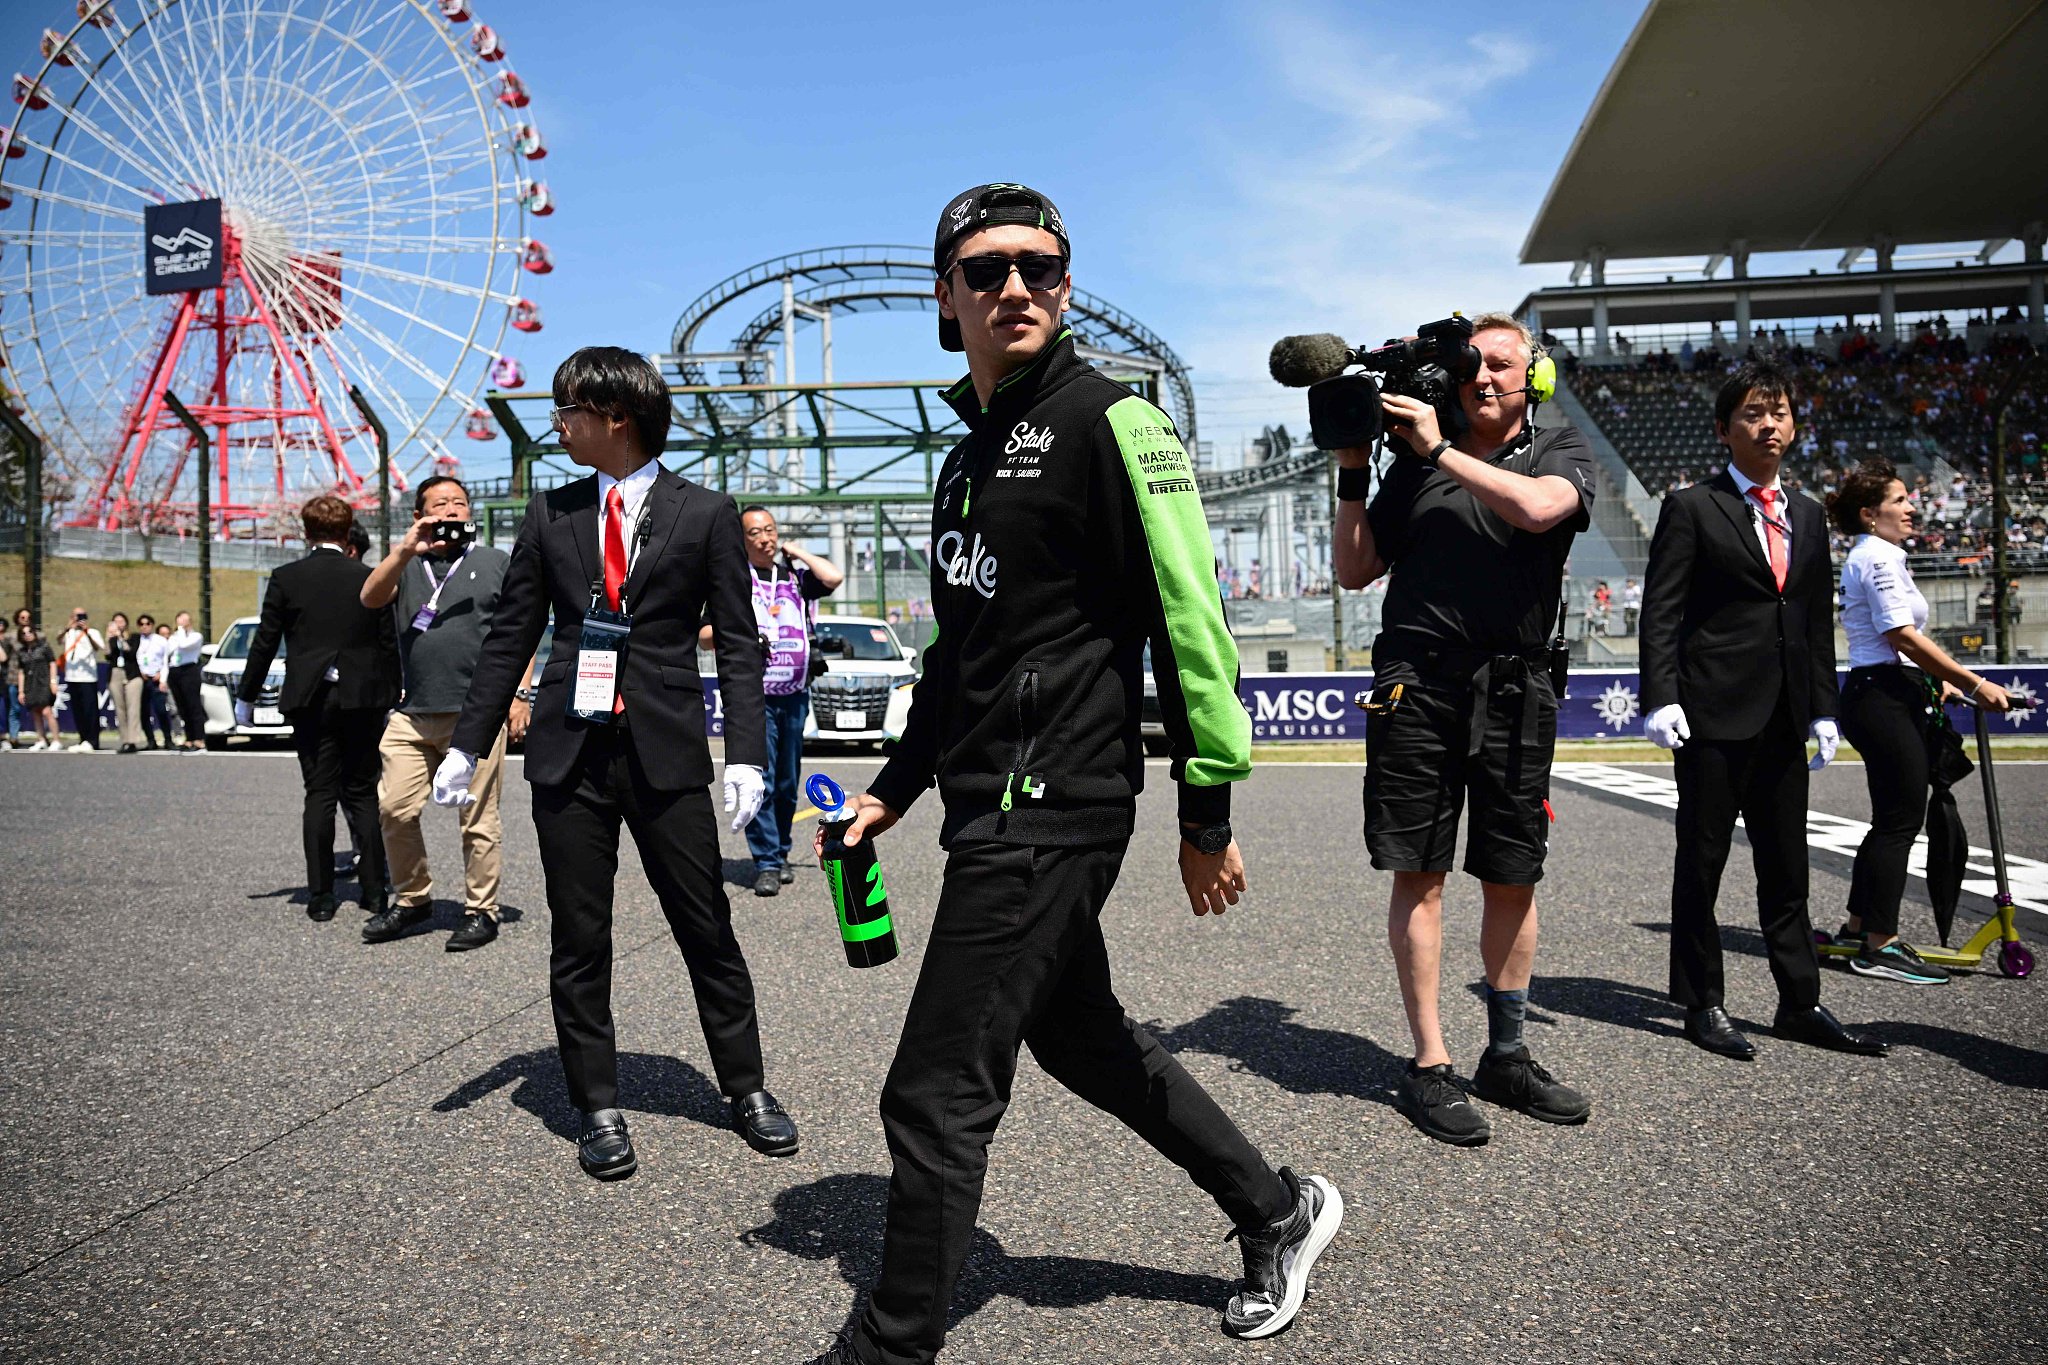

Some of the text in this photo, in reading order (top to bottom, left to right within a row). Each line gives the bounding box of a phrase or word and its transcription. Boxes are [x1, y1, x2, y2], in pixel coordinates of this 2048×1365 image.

[155, 260, 211, 276] CIRCUIT
[1004, 421, 1055, 454] Stake
[1018, 456, 1040, 464] TEAM
[1138, 450, 1183, 465] MASCOT
[995, 469, 1013, 478] KICK
[1141, 462, 1188, 474] WORKWEAR
[1147, 478, 1195, 495] PIRELLI
[1253, 689, 1346, 722] MSC
[1254, 724, 1346, 736] CRUISES
